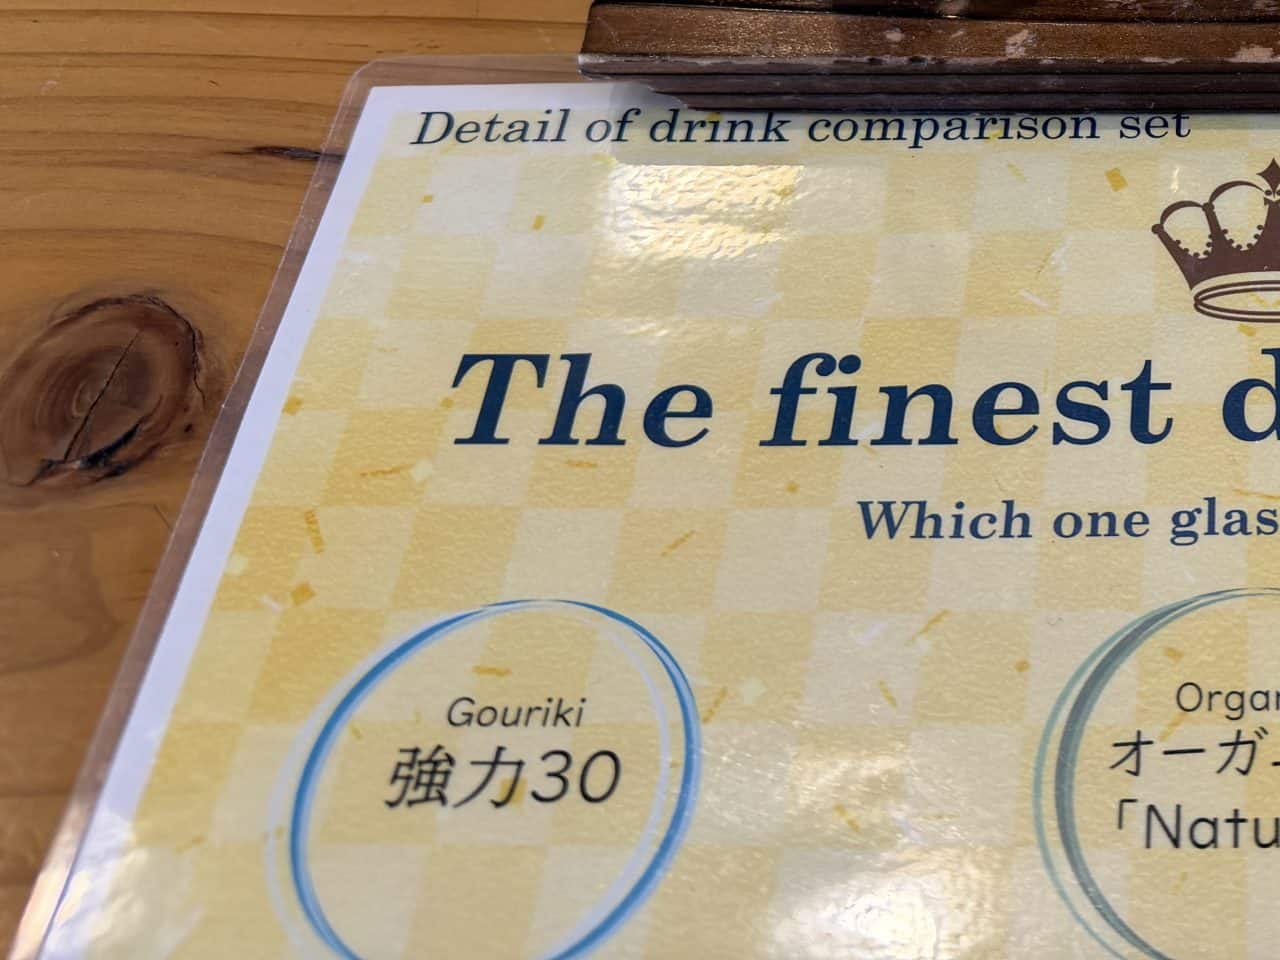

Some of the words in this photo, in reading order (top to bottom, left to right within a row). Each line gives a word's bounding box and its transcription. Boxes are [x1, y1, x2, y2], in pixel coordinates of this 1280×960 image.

[409, 108, 571, 145] Detail
[585, 108, 641, 143] of
[649, 109, 792, 143] drink
[807, 113, 1102, 149] comparison
[1118, 113, 1193, 139] set
[451, 353, 713, 448] The
[758, 352, 1174, 447] finest
[856, 499, 1033, 540] Which
[1053, 511, 1150, 539] one
[447, 696, 587, 728] Gouriki
[385, 744, 622, 809] 強力30
